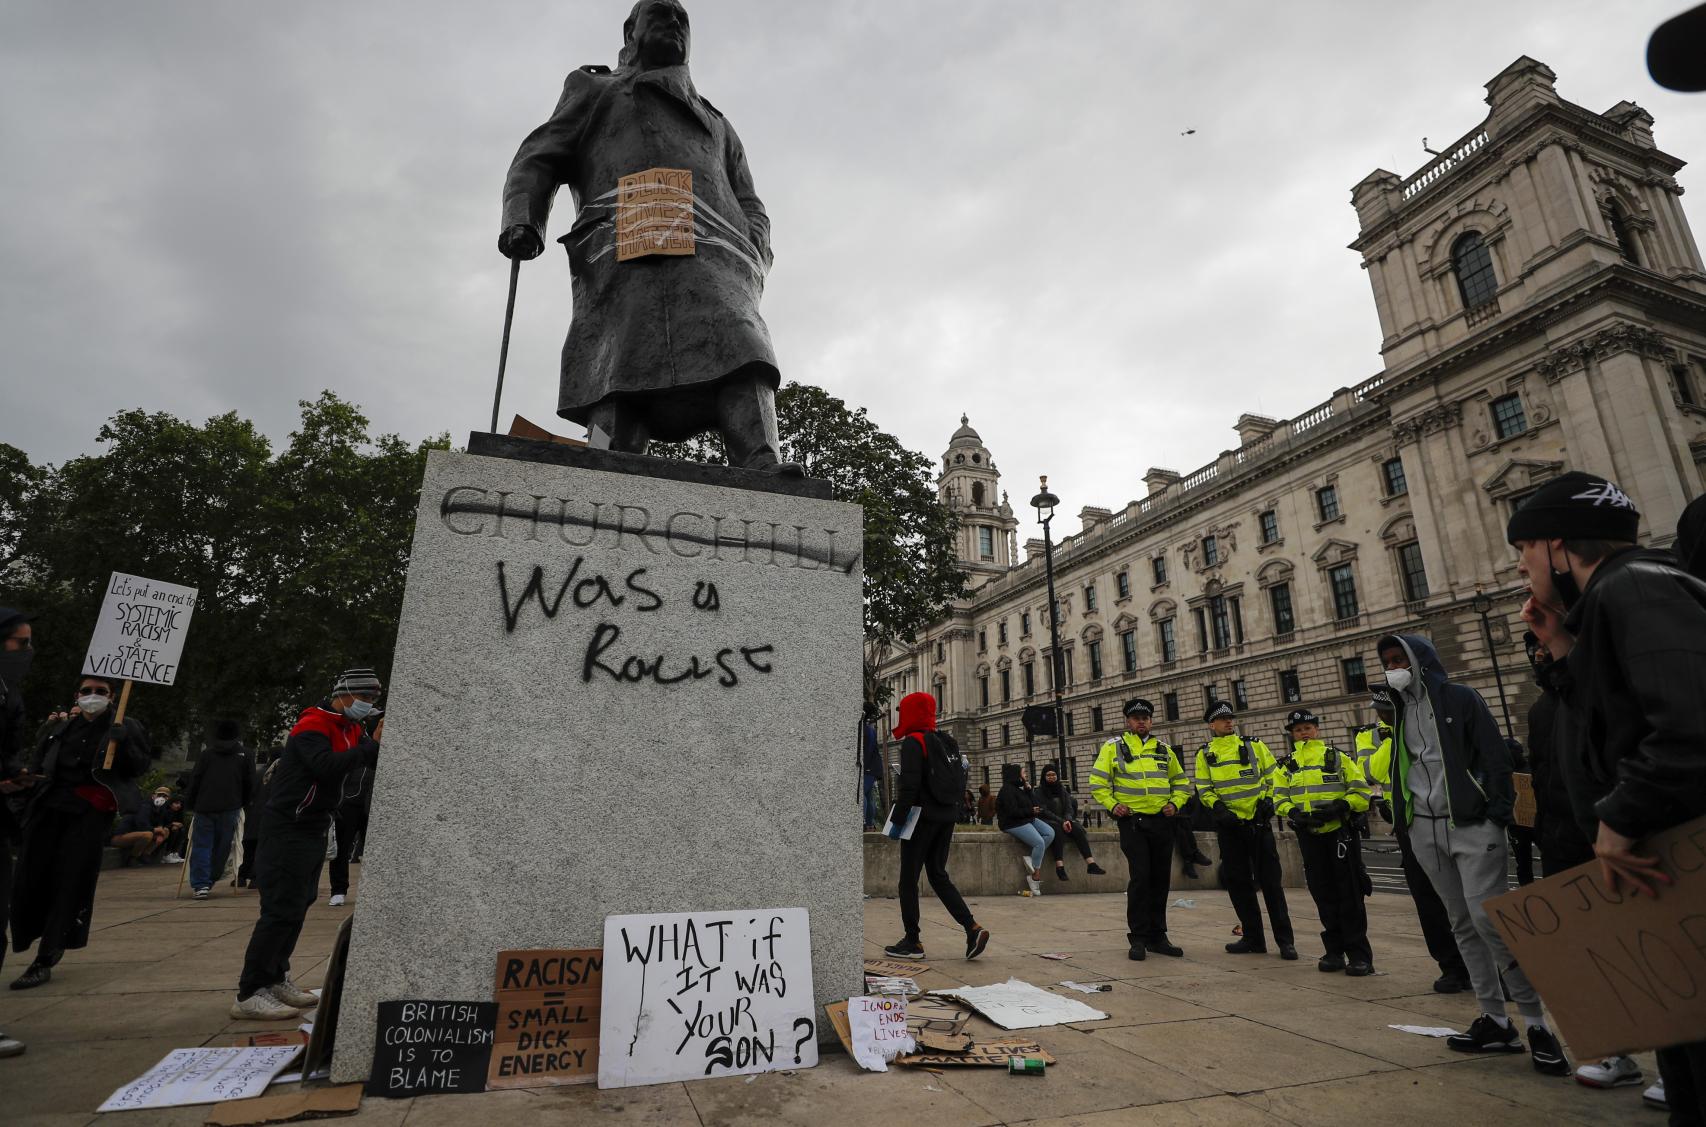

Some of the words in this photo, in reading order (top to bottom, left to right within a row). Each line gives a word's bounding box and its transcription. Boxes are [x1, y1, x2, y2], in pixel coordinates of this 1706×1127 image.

[623, 171, 692, 202] BLACK
[621, 198, 691, 226] LIVES
[621, 225, 695, 256] MATTER
[441, 486, 853, 575] CHURCHILL
[133, 583, 150, 601] put
[152, 590, 165, 600] an
[168, 594, 185, 605] end
[187, 593, 196, 607] to
[497, 556, 663, 634] Was
[692, 580, 720, 611] a
[121, 621, 171, 643] RACISM
[115, 645, 159, 663] STATE
[1496, 895, 1560, 942] NO
[621, 918, 733, 968] WHAT
[676, 965, 721, 996] IT
[735, 960, 786, 998] WAS
[1586, 929, 1698, 1028] NO
[401, 1002, 479, 1024] BRITISH
[508, 1005, 589, 1030] SMALL
[879, 1012, 905, 1026] ENDS
[385, 1025, 494, 1046] COLONIALISM
[667, 997, 758, 1055] YOUR
[873, 1027, 908, 1041] LIVES
[517, 1030, 571, 1051] DICK
[981, 1044, 1041, 1056] LIVES
[398, 1048, 416, 1063] IS
[431, 1049, 453, 1063] TO
[498, 1049, 588, 1077] ENERGY
[390, 1066, 461, 1089] BLAME
